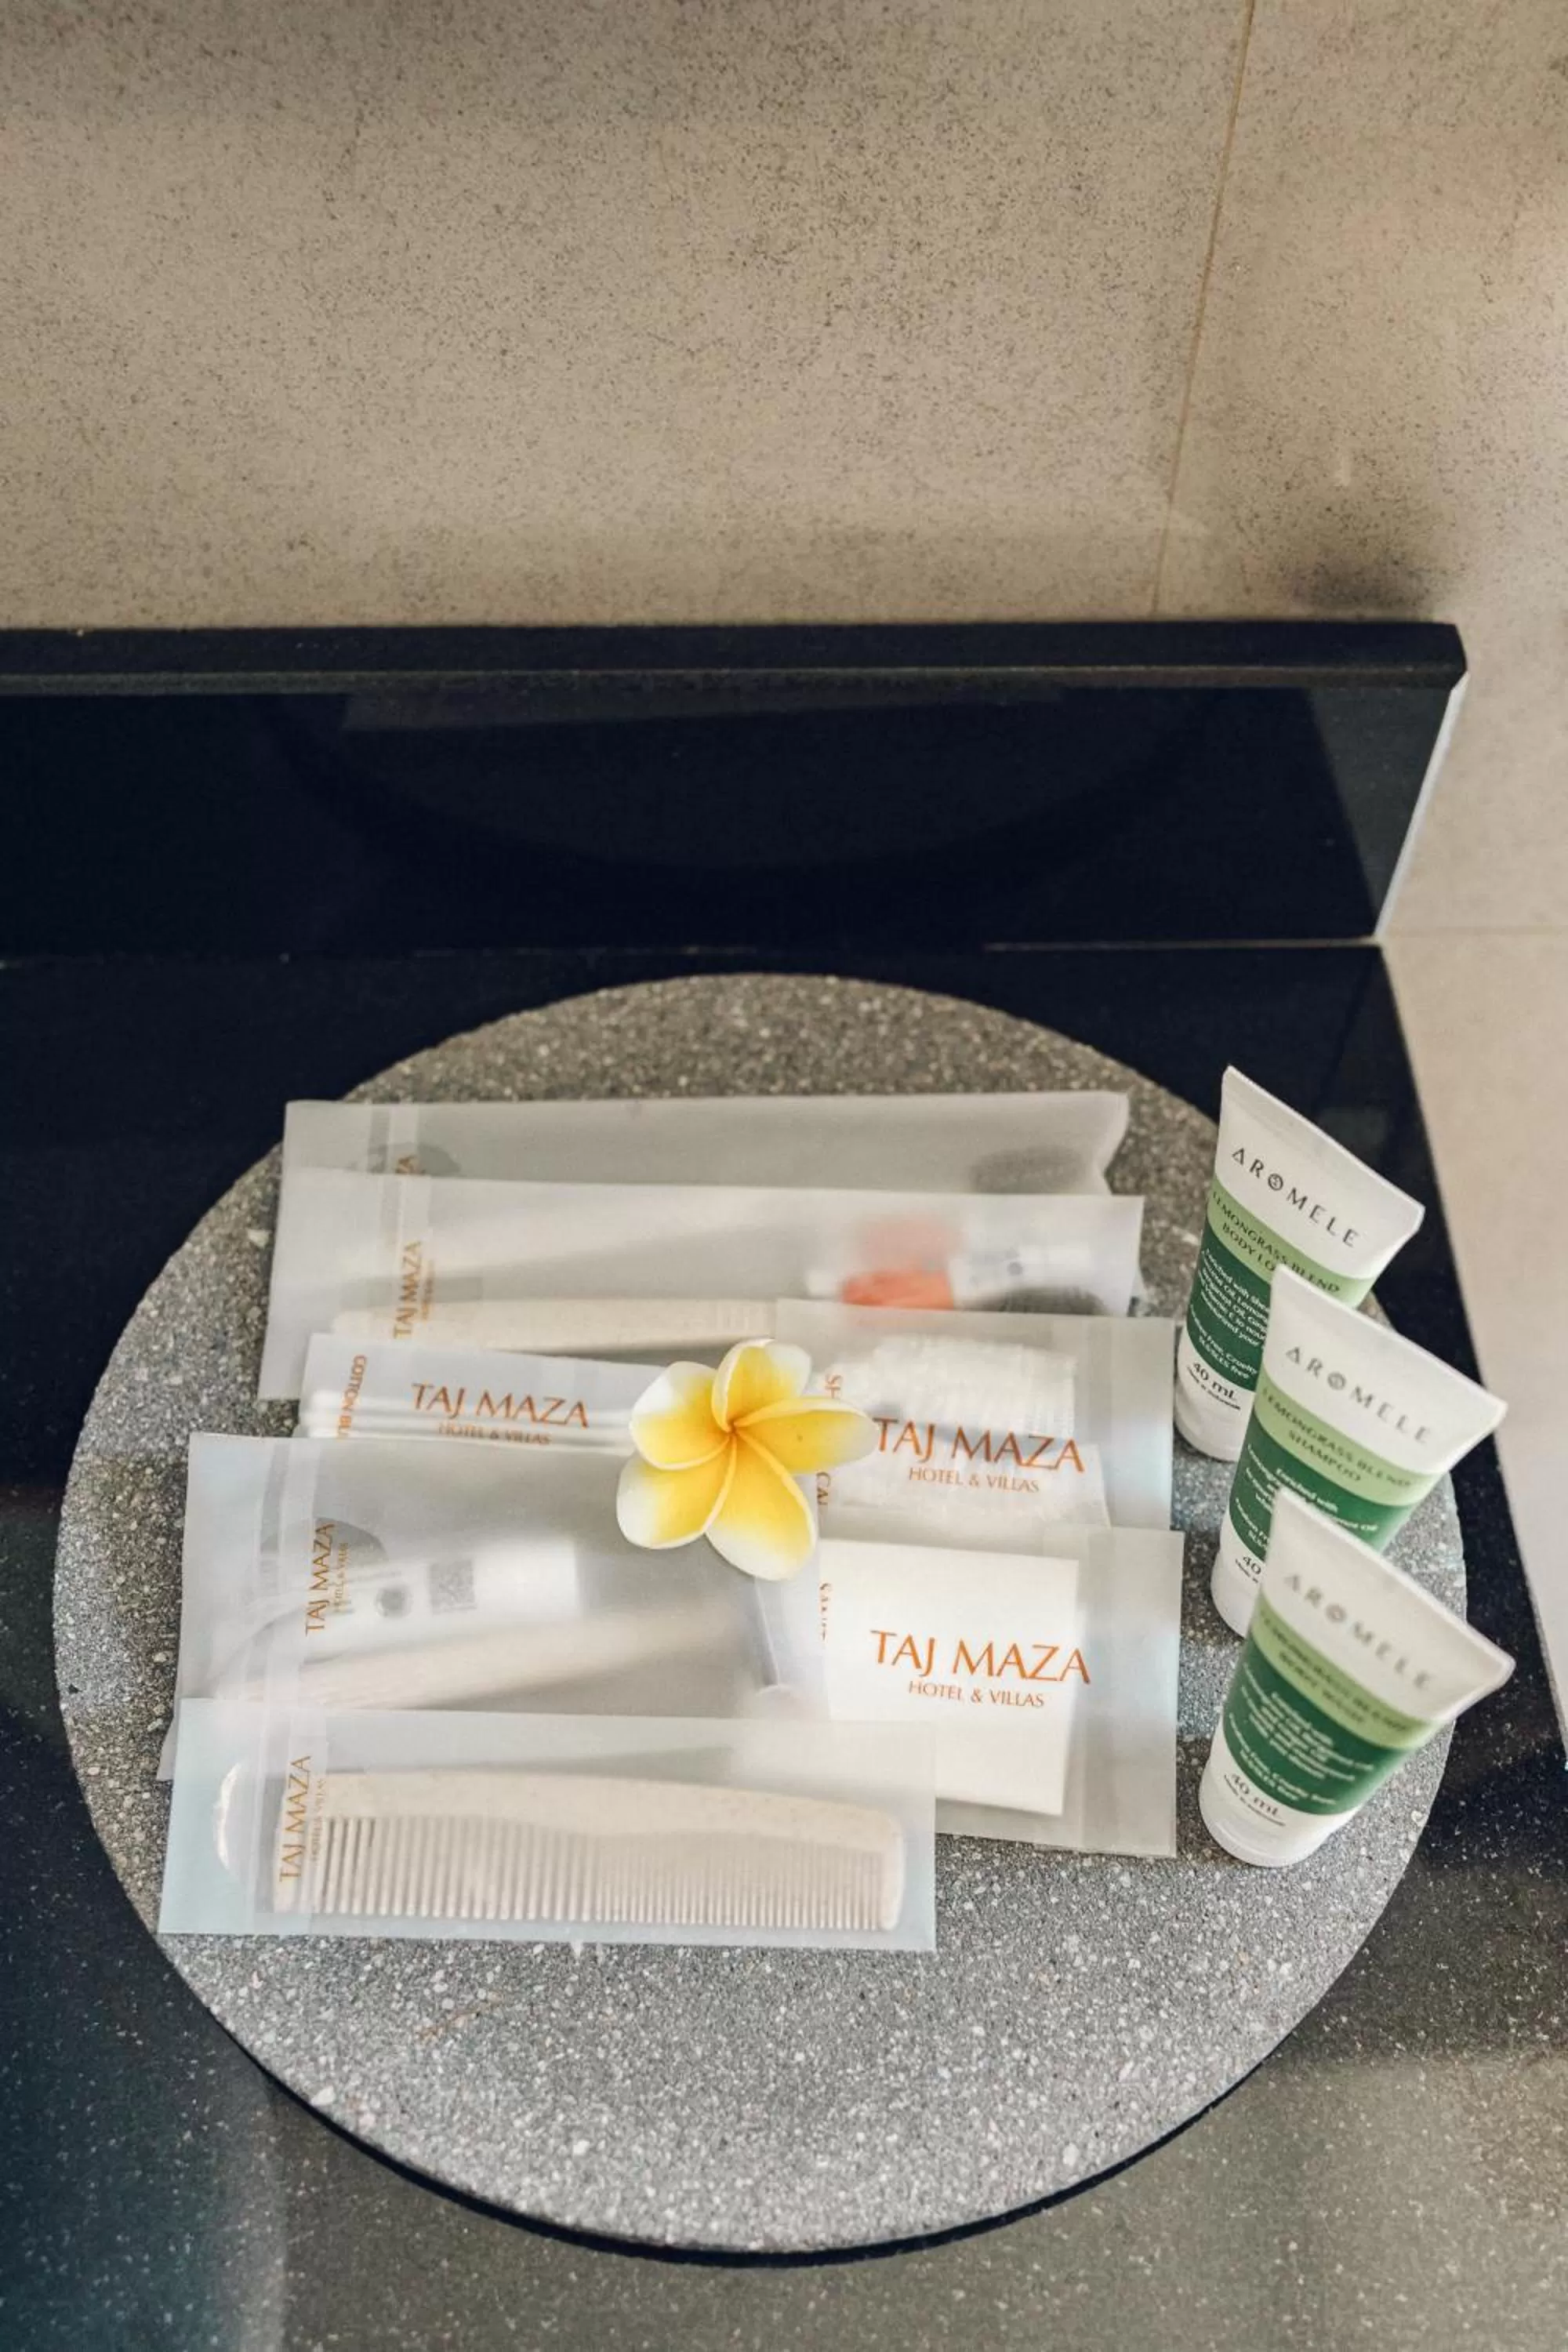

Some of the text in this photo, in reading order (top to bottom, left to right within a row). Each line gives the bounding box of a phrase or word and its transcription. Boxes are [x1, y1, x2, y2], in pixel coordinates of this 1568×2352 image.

[1232, 1147, 1361, 1248] AROMELE
[1213, 1191, 1288, 1265] LEMONGRASS
[1222, 1222, 1256, 1255] BODY
[1192, 1363, 1210, 1381] 40
[1286, 1346, 1432, 1444] AROMELE
[412, 1383, 590, 1429] TAJ MAZA
[872, 1417, 1085, 1473] TAJ MAZA
[908, 1466, 1040, 1494] HOTEL & VILLAS
[305, 1523, 335, 1637] TAJ MAZA
[1242, 1555, 1262, 1576] 40
[870, 1629, 1091, 1685] TAJ MAZA
[908, 1680, 1045, 1709] HOTEL & VILLAS
[278, 1755, 312, 1882] TAJ MAZA
